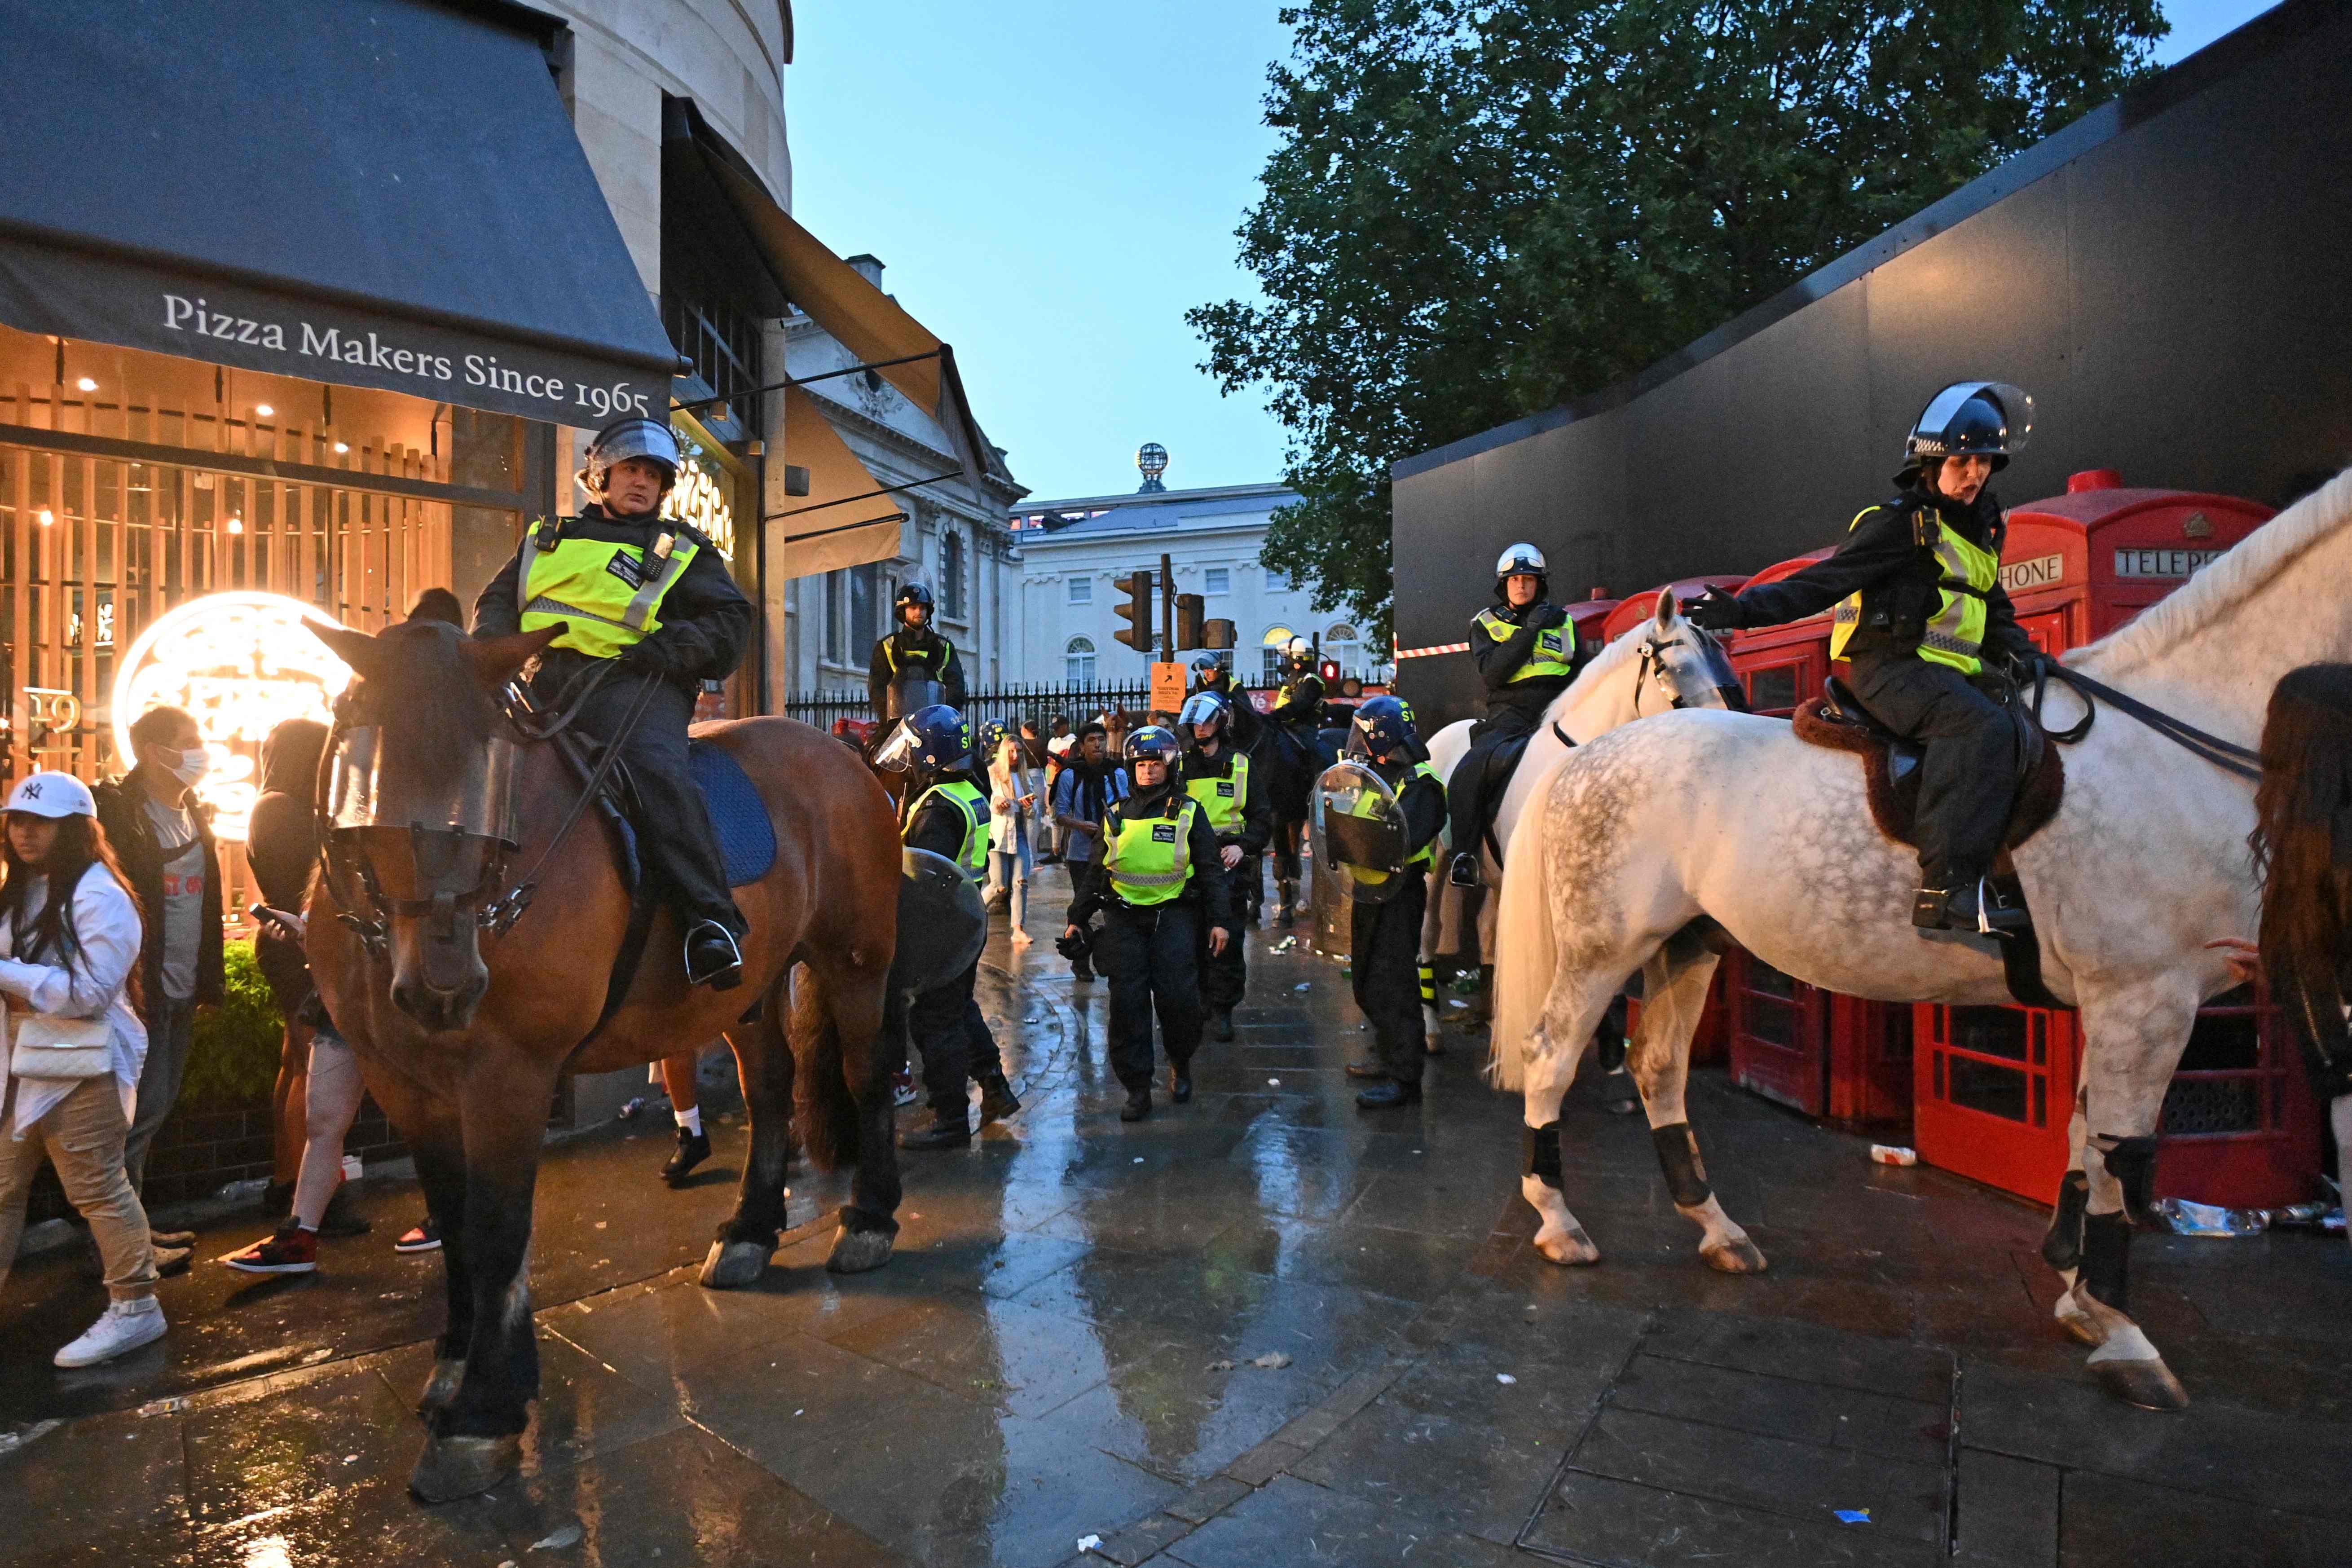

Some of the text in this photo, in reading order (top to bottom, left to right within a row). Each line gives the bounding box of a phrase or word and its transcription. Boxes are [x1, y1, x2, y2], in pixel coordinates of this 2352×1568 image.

[163, 294, 649, 418] Pizza Makers Since 1965
